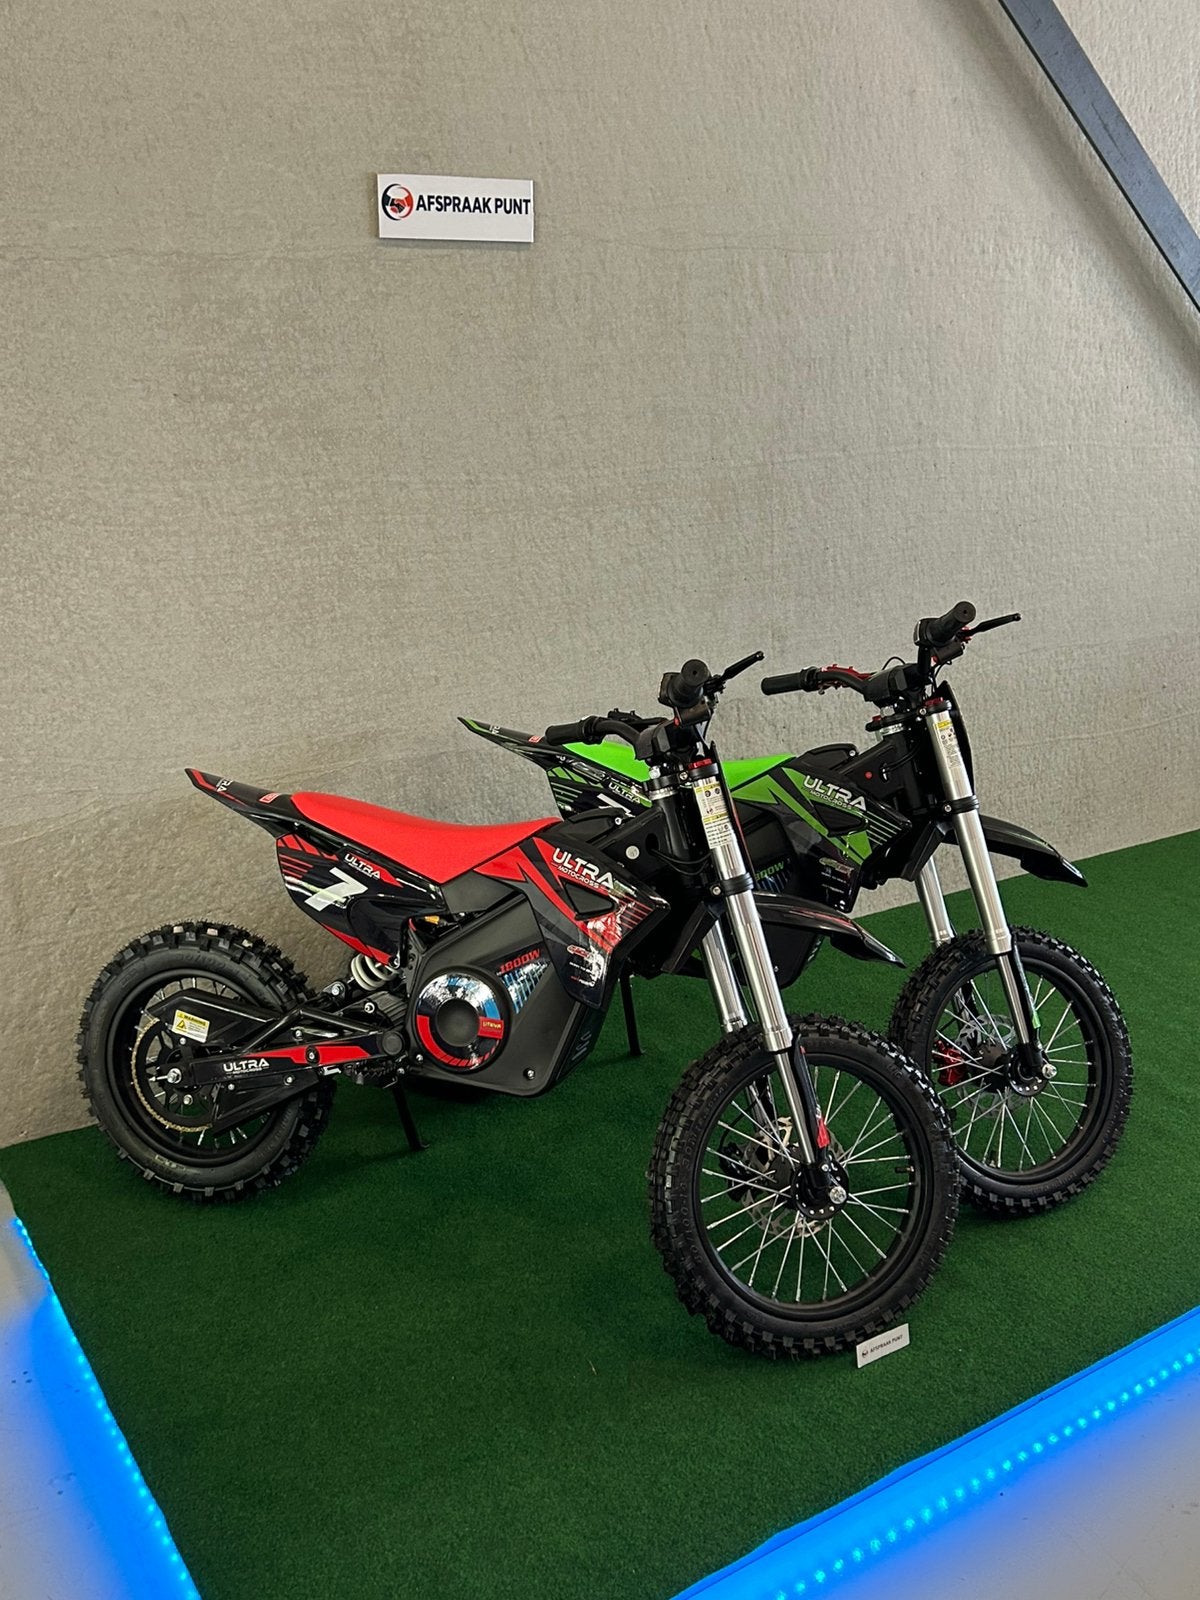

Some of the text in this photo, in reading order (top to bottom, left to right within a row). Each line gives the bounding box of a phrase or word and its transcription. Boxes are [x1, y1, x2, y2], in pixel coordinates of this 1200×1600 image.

[416, 195, 531, 215] AFSPRAAK PUNT
[608, 782, 641, 804] ULTRA
[803, 775, 867, 811] ULTRA
[810, 789, 852, 810] MOTOCROSS
[344, 853, 381, 880] ULTRA
[552, 847, 614, 889] ULTRA
[557, 865, 600, 889] MOTOCROSS
[223, 1057, 270, 1072] ULTRA
